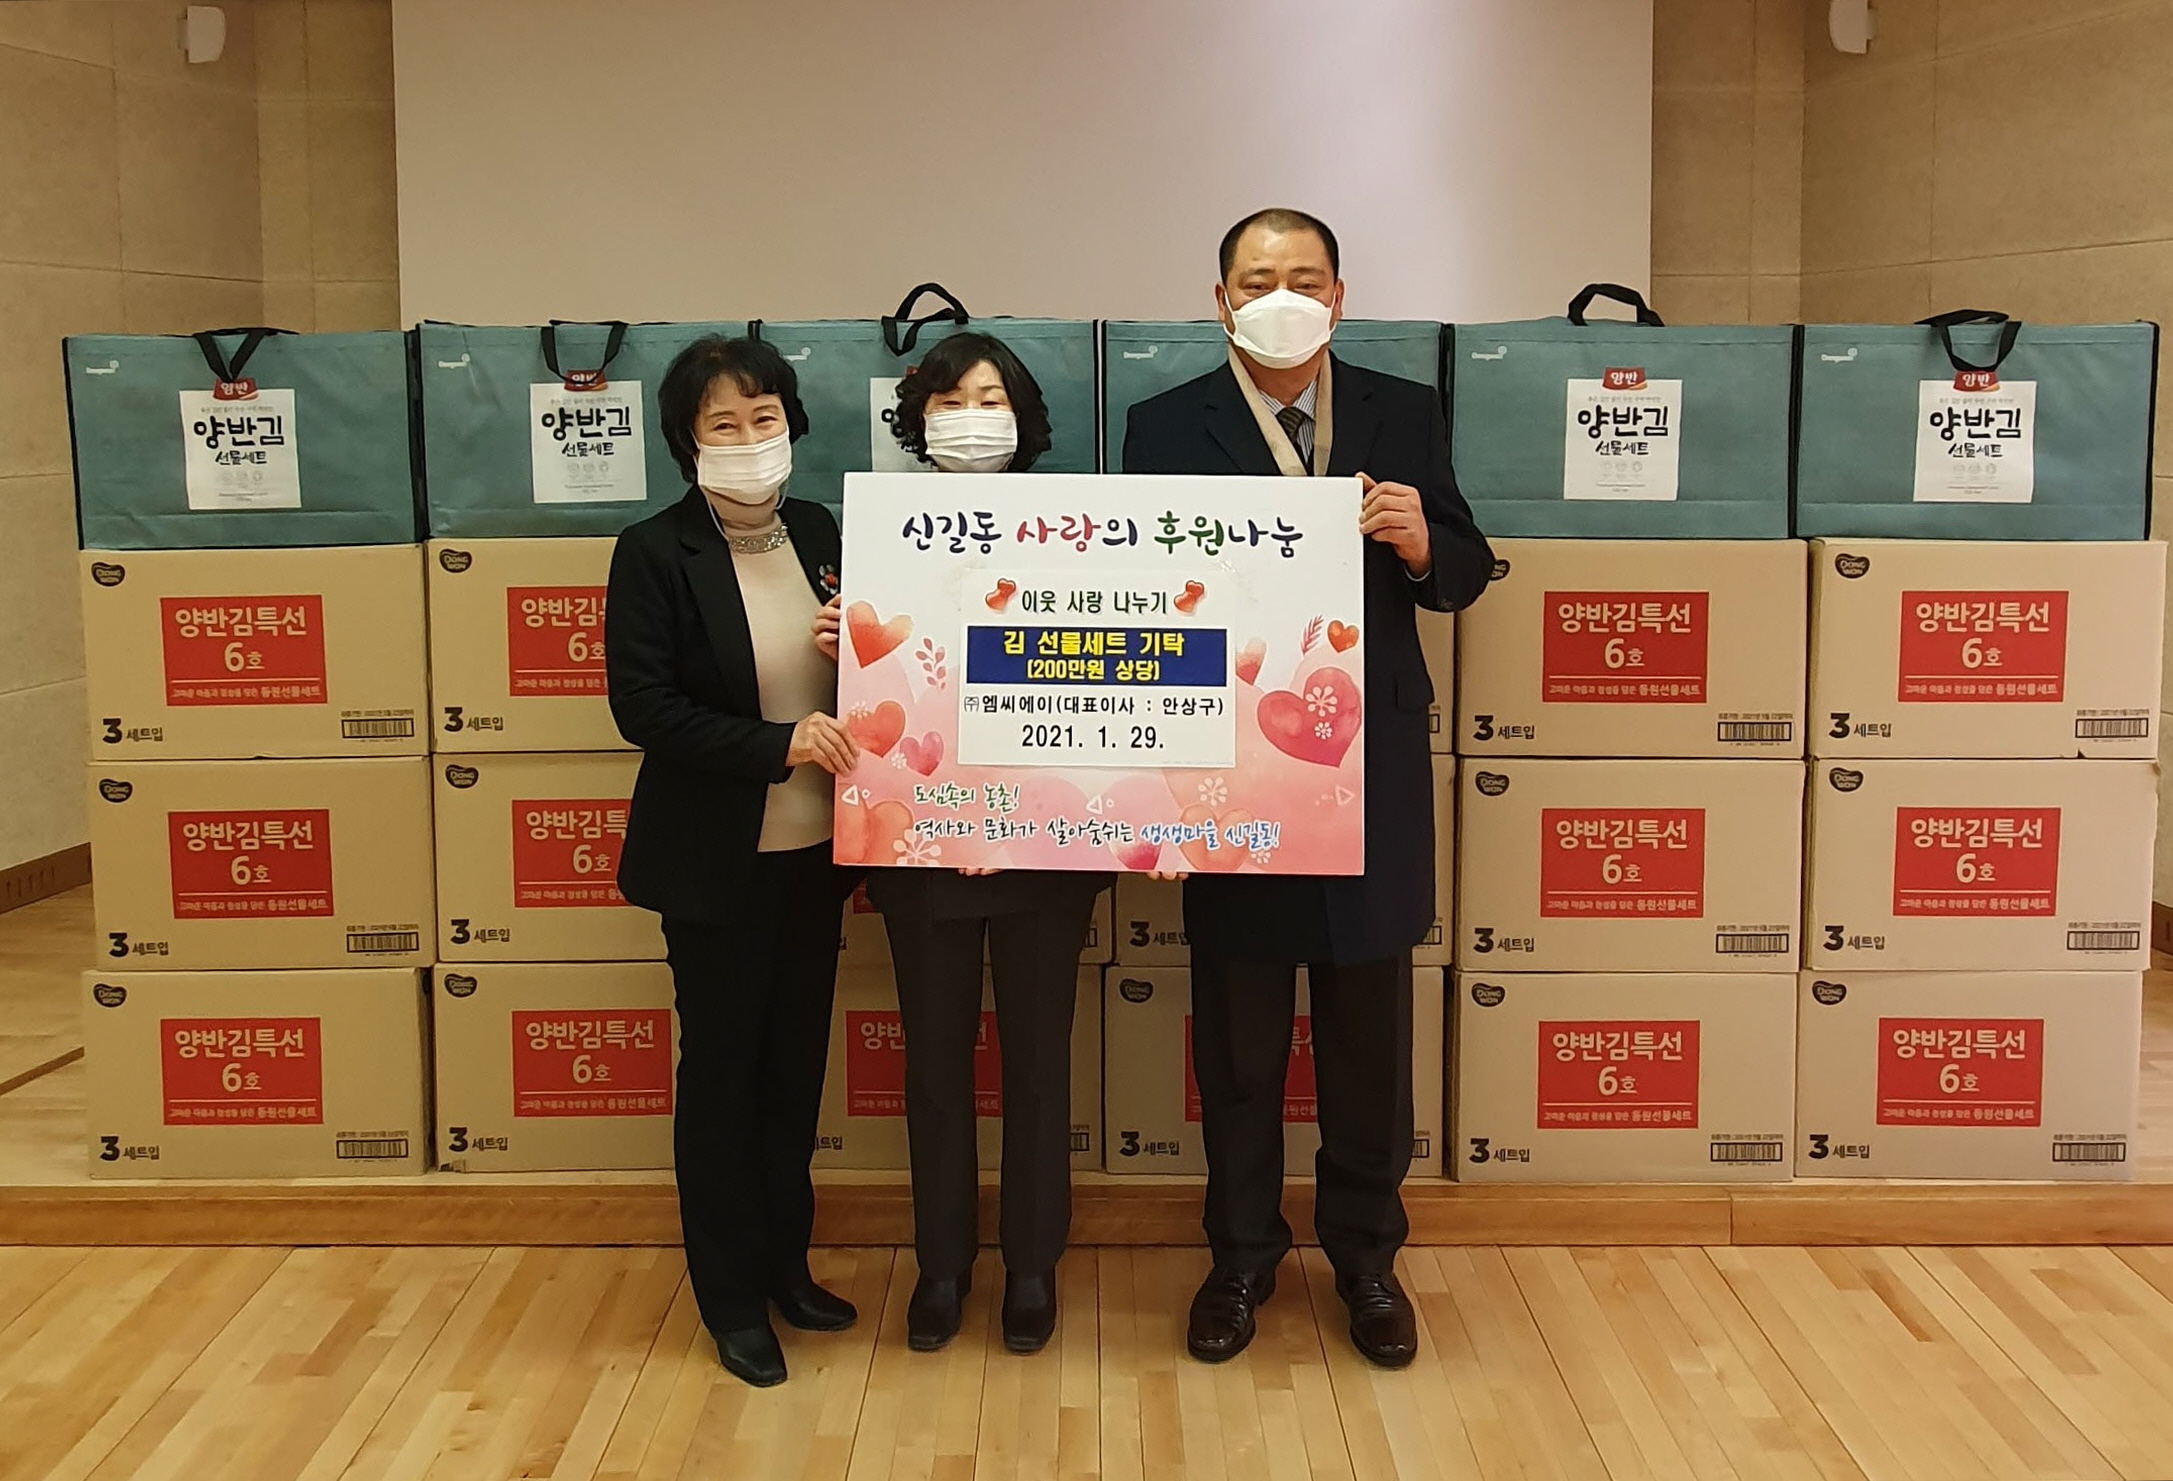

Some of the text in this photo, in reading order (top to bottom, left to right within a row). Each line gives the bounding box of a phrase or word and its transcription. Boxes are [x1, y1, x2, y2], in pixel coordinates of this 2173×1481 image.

[220, 383, 247, 395] 양반
[1611, 372, 1637, 384] 양반
[1962, 374, 1990, 387] 양반
[194, 416, 284, 449] 양반김
[542, 406, 632, 443] 양반김
[1578, 405, 1668, 439] 양반김
[1930, 407, 2021, 441] 양반김
[216, 450, 267, 465] 선물세트
[562, 442, 614, 457] 선물세트
[1596, 440, 1648, 456] 선물세트
[1948, 443, 2002, 458] 선물세트
[903, 511, 1302, 558] 신길동 사랑의 후원나눔
[522, 597, 606, 627] 양반김
[1022, 591, 1167, 614] 이웃 사랑 나누기
[176, 606, 306, 638] 양반김특선
[1559, 603, 1691, 633] 양반김특선
[1917, 602, 2049, 633] 양반김특선
[1004, 631, 1184, 656] 김 선물세트 기탁
[1163, 697, 1223, 715] 안상구)
[103, 718, 163, 744] 3 세트입
[444, 707, 503, 732] 3 세트입
[1473, 715, 1534, 741] 3 세트입
[1829, 713, 1891, 738] 3 세트입
[1022, 725, 1164, 748] 2021. 1. 29.
[915, 784, 1019, 812] 도심속의 농촌!
[184, 821, 313, 851] 양반김특선
[916, 820, 1280, 849] 역사와 문화가 살아숨쉬는 생생마을 신길동!
[1557, 820, 1687, 849] 양반김특선
[1912, 818, 2042, 848] 양반김특선
[451, 919, 510, 944] 3 세트입
[1130, 921, 1150, 947] 3
[1474, 928, 1534, 953] 3 세트입
[1824, 926, 1885, 951] 3 세트입
[109, 933, 169, 957] 3 세트입
[176, 1029, 304, 1058] 양반김특선
[526, 1020, 654, 1050] 양반김특선
[1553, 1031, 1682, 1061] 양반김특선
[1894, 1029, 2025, 1059] 양반김특선
[100, 1136, 160, 1161] 3 세트입
[449, 1127, 508, 1152] 3 세트입
[1120, 1131, 1179, 1156] 3 세트입
[1469, 1138, 1530, 1163] 3 세트입
[1809, 1134, 1870, 1159] 3 세트입
